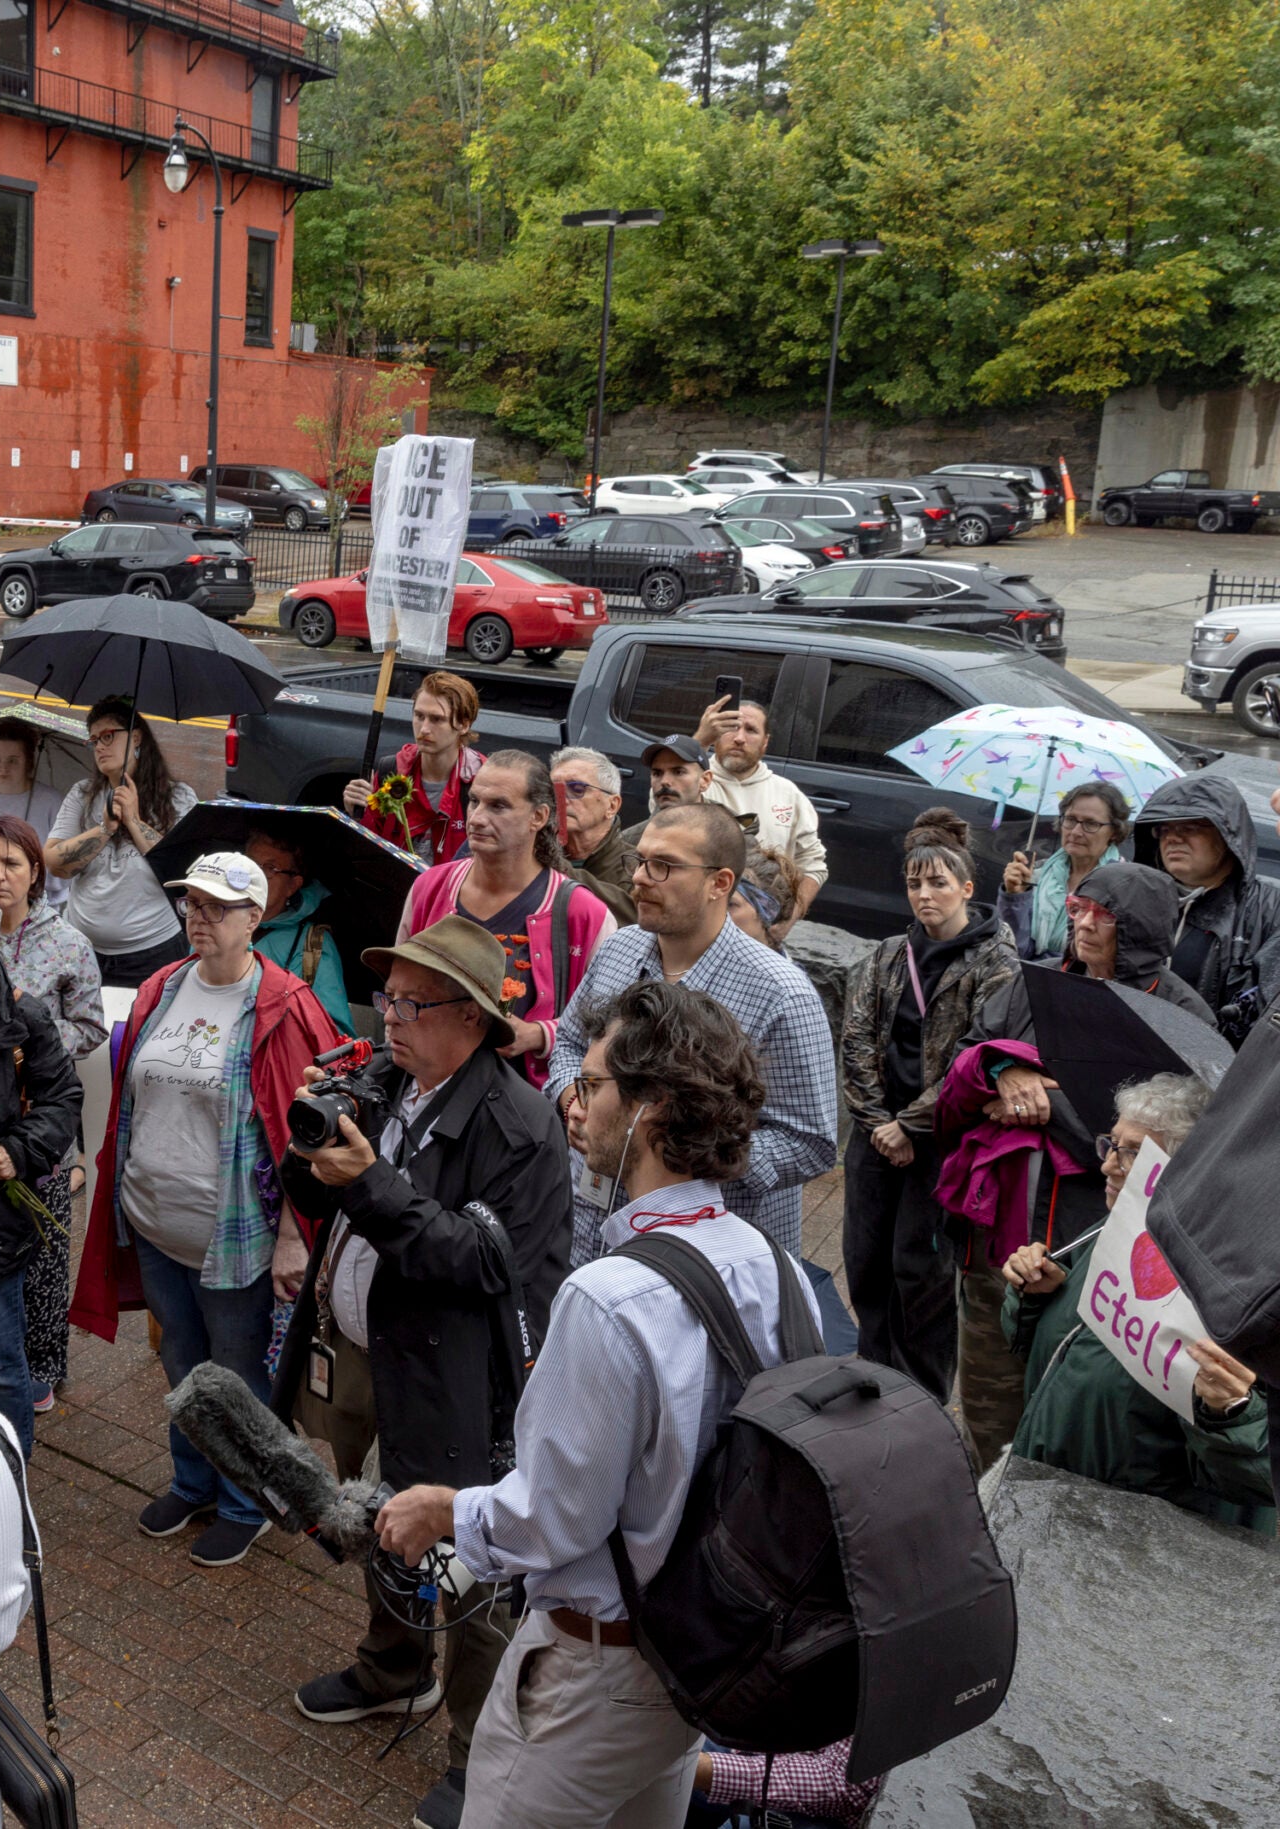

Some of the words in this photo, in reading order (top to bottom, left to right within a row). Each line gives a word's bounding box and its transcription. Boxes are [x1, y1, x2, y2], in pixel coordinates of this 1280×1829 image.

[405, 443, 446, 480] ICE
[400, 526, 423, 549] OF
[152, 1022, 184, 1041] etel
[144, 1069, 164, 1086] for
[167, 1076, 222, 1090] worceste
[518, 1309, 532, 1358] SONY
[1090, 1269, 1182, 1391] Etel!
